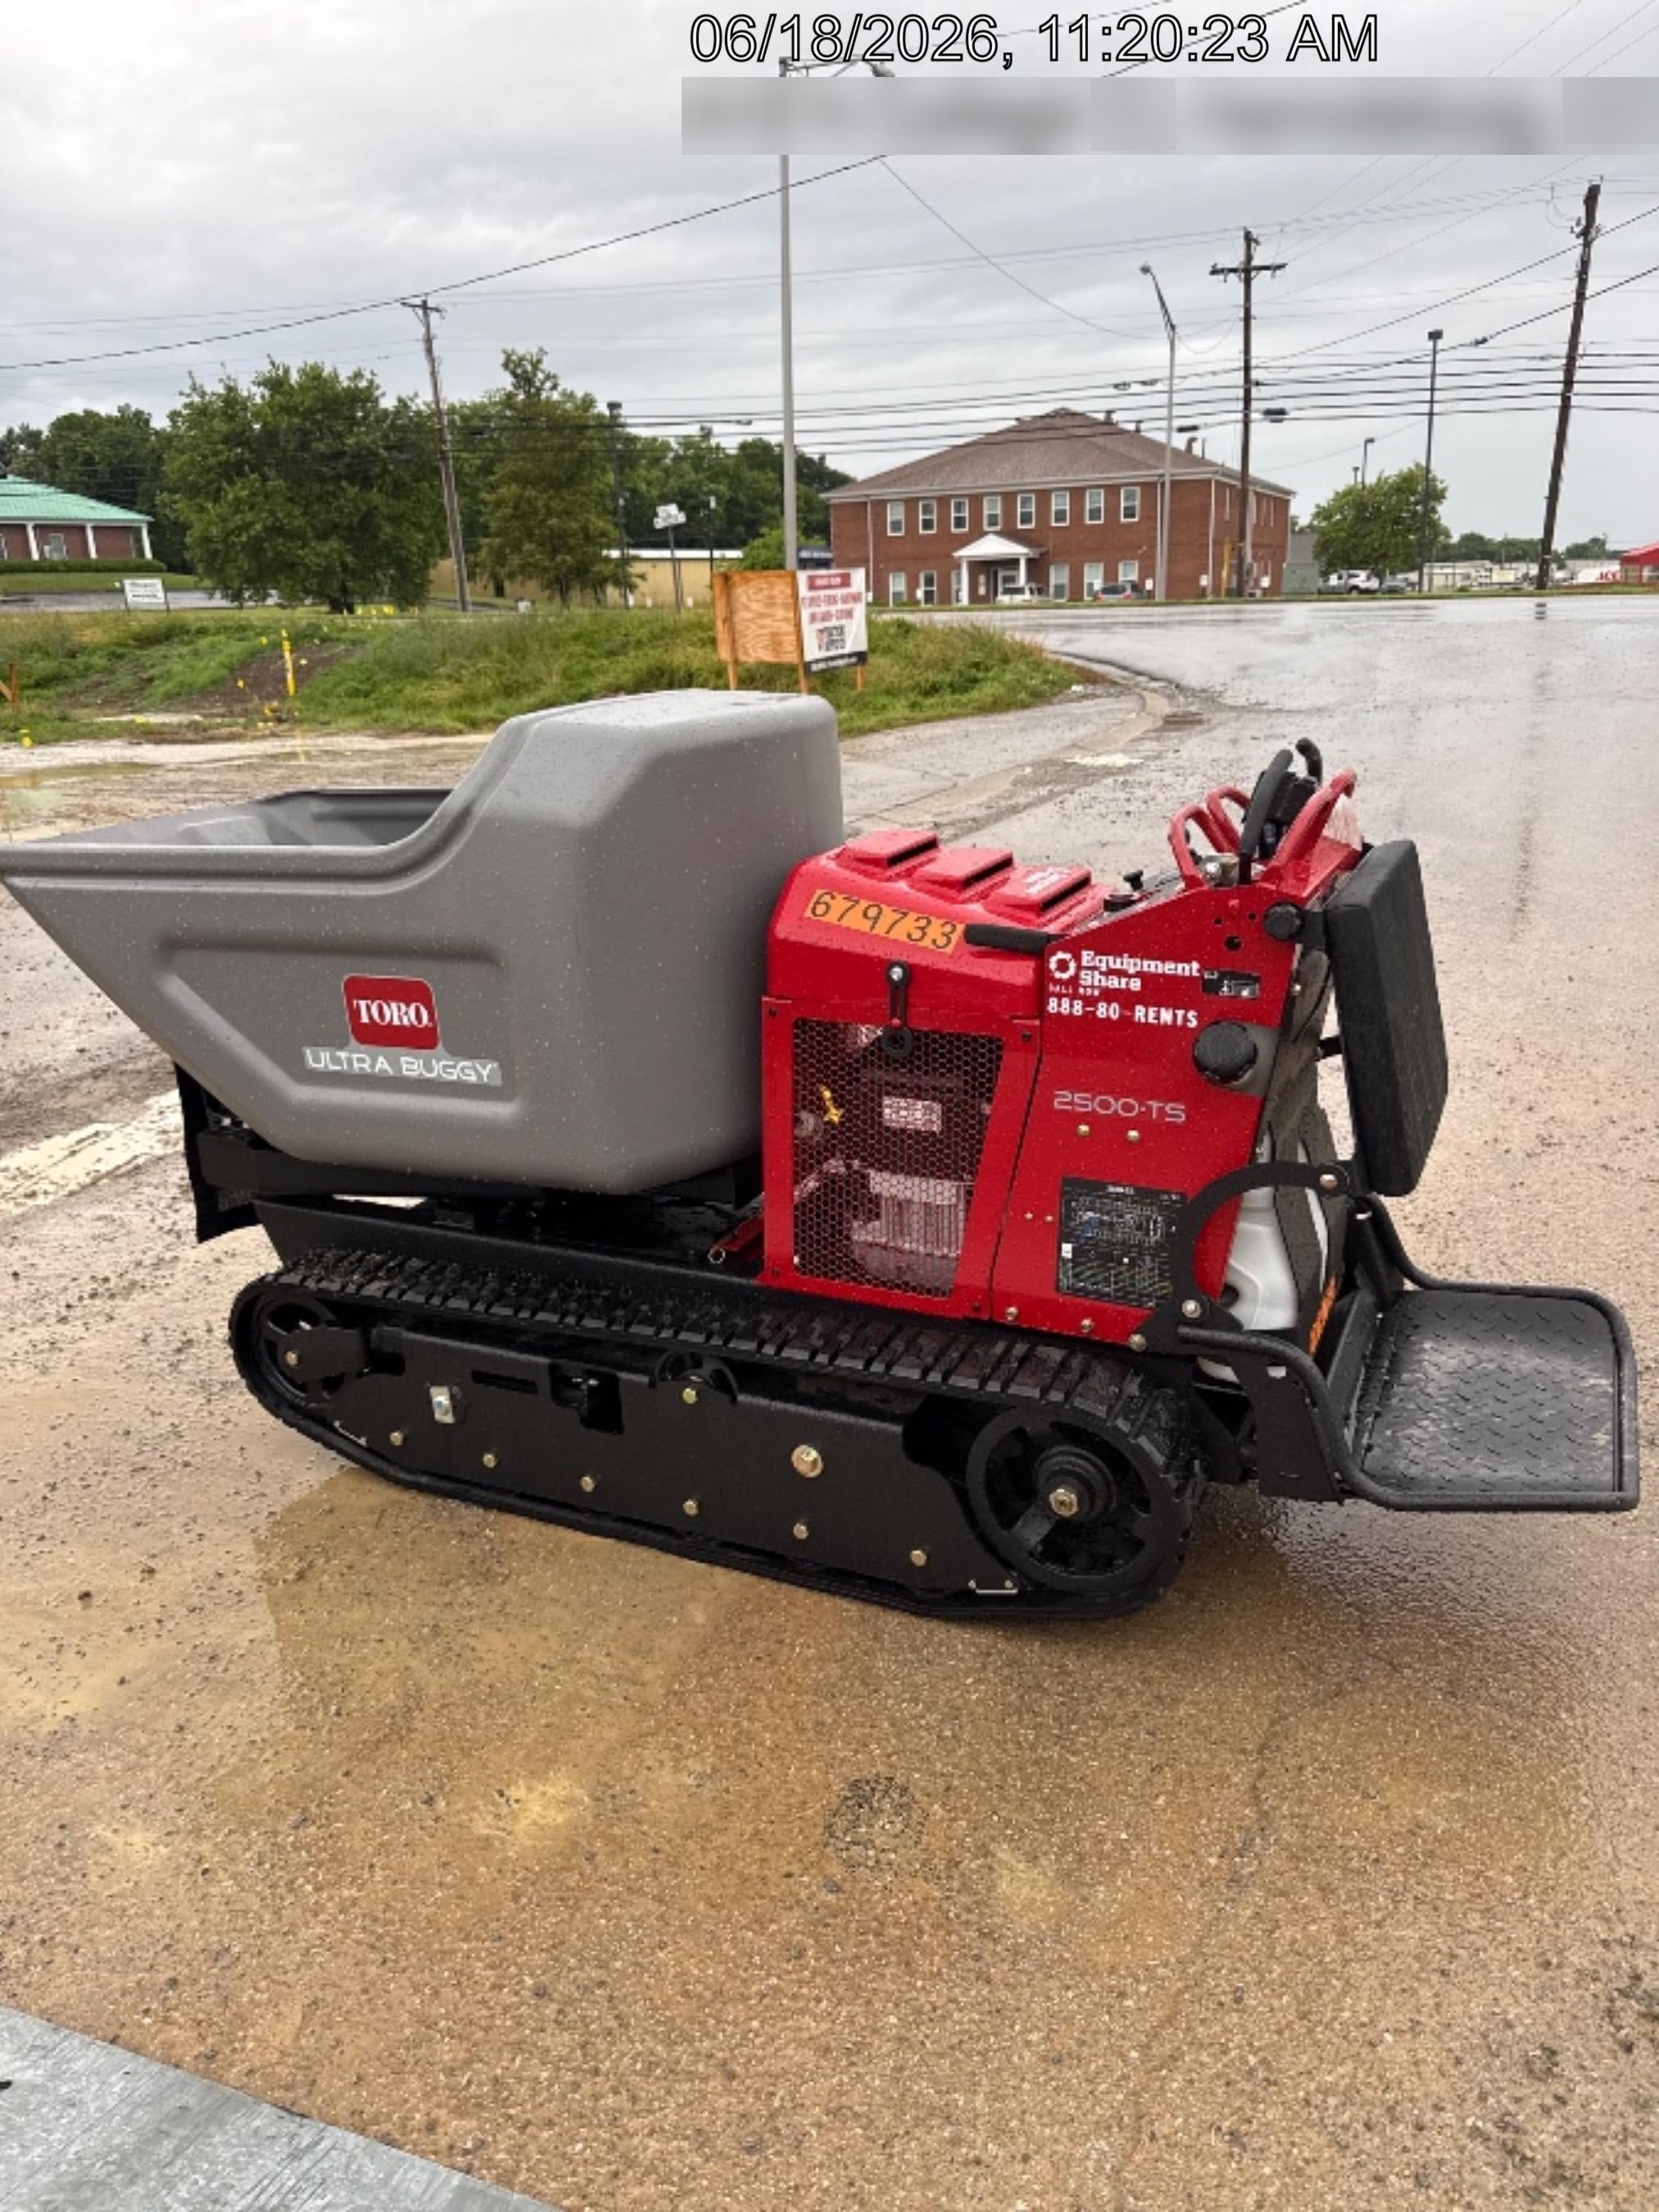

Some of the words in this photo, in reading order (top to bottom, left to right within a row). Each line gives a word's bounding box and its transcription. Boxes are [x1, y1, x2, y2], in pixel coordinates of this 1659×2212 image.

[811, 891, 957, 950] 679733
[1081, 950, 1201, 977] Equipment
[1079, 970, 1141, 991] Share
[353, 999, 429, 1028] TORO
[306, 1049, 393, 1075] ULTRA
[399, 1056, 494, 1083] BUGGY
